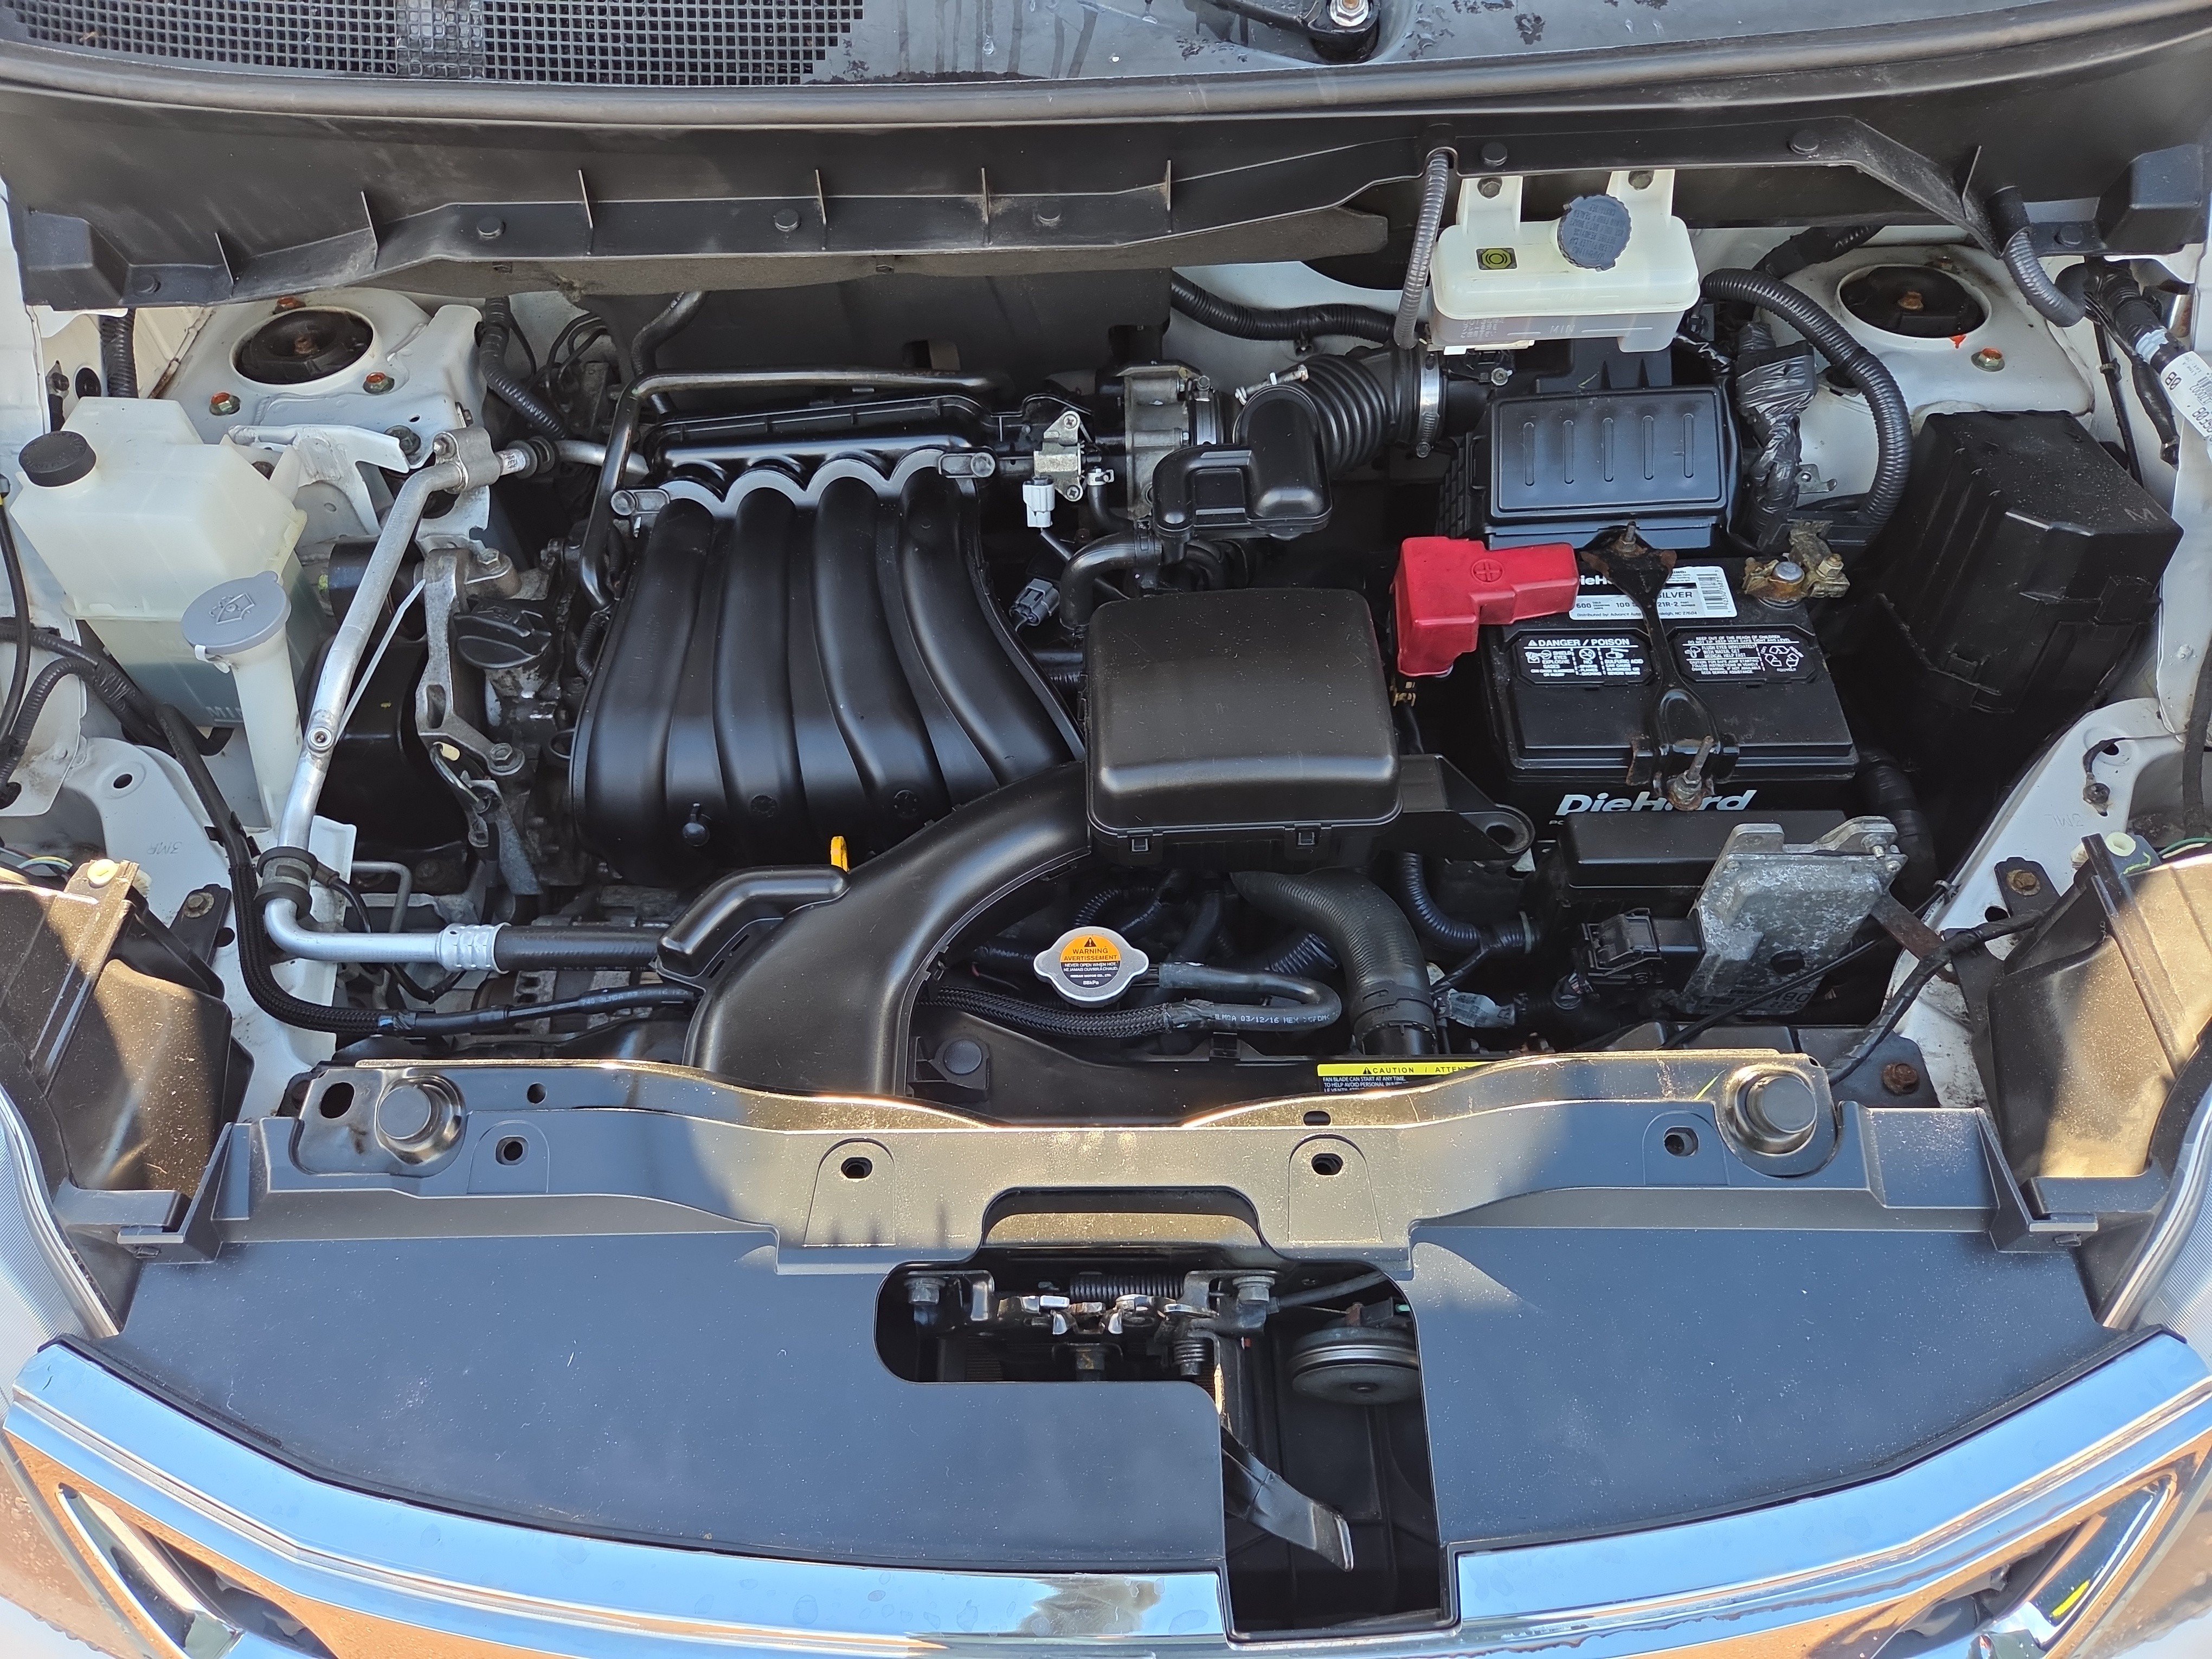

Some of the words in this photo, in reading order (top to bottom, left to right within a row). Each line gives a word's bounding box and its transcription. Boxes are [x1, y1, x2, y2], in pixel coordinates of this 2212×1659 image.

[1549, 324, 1575, 333] MIN
[1555, 789, 1758, 815] DieHrd
[1240, 1015, 1279, 1024] 03/12/16
